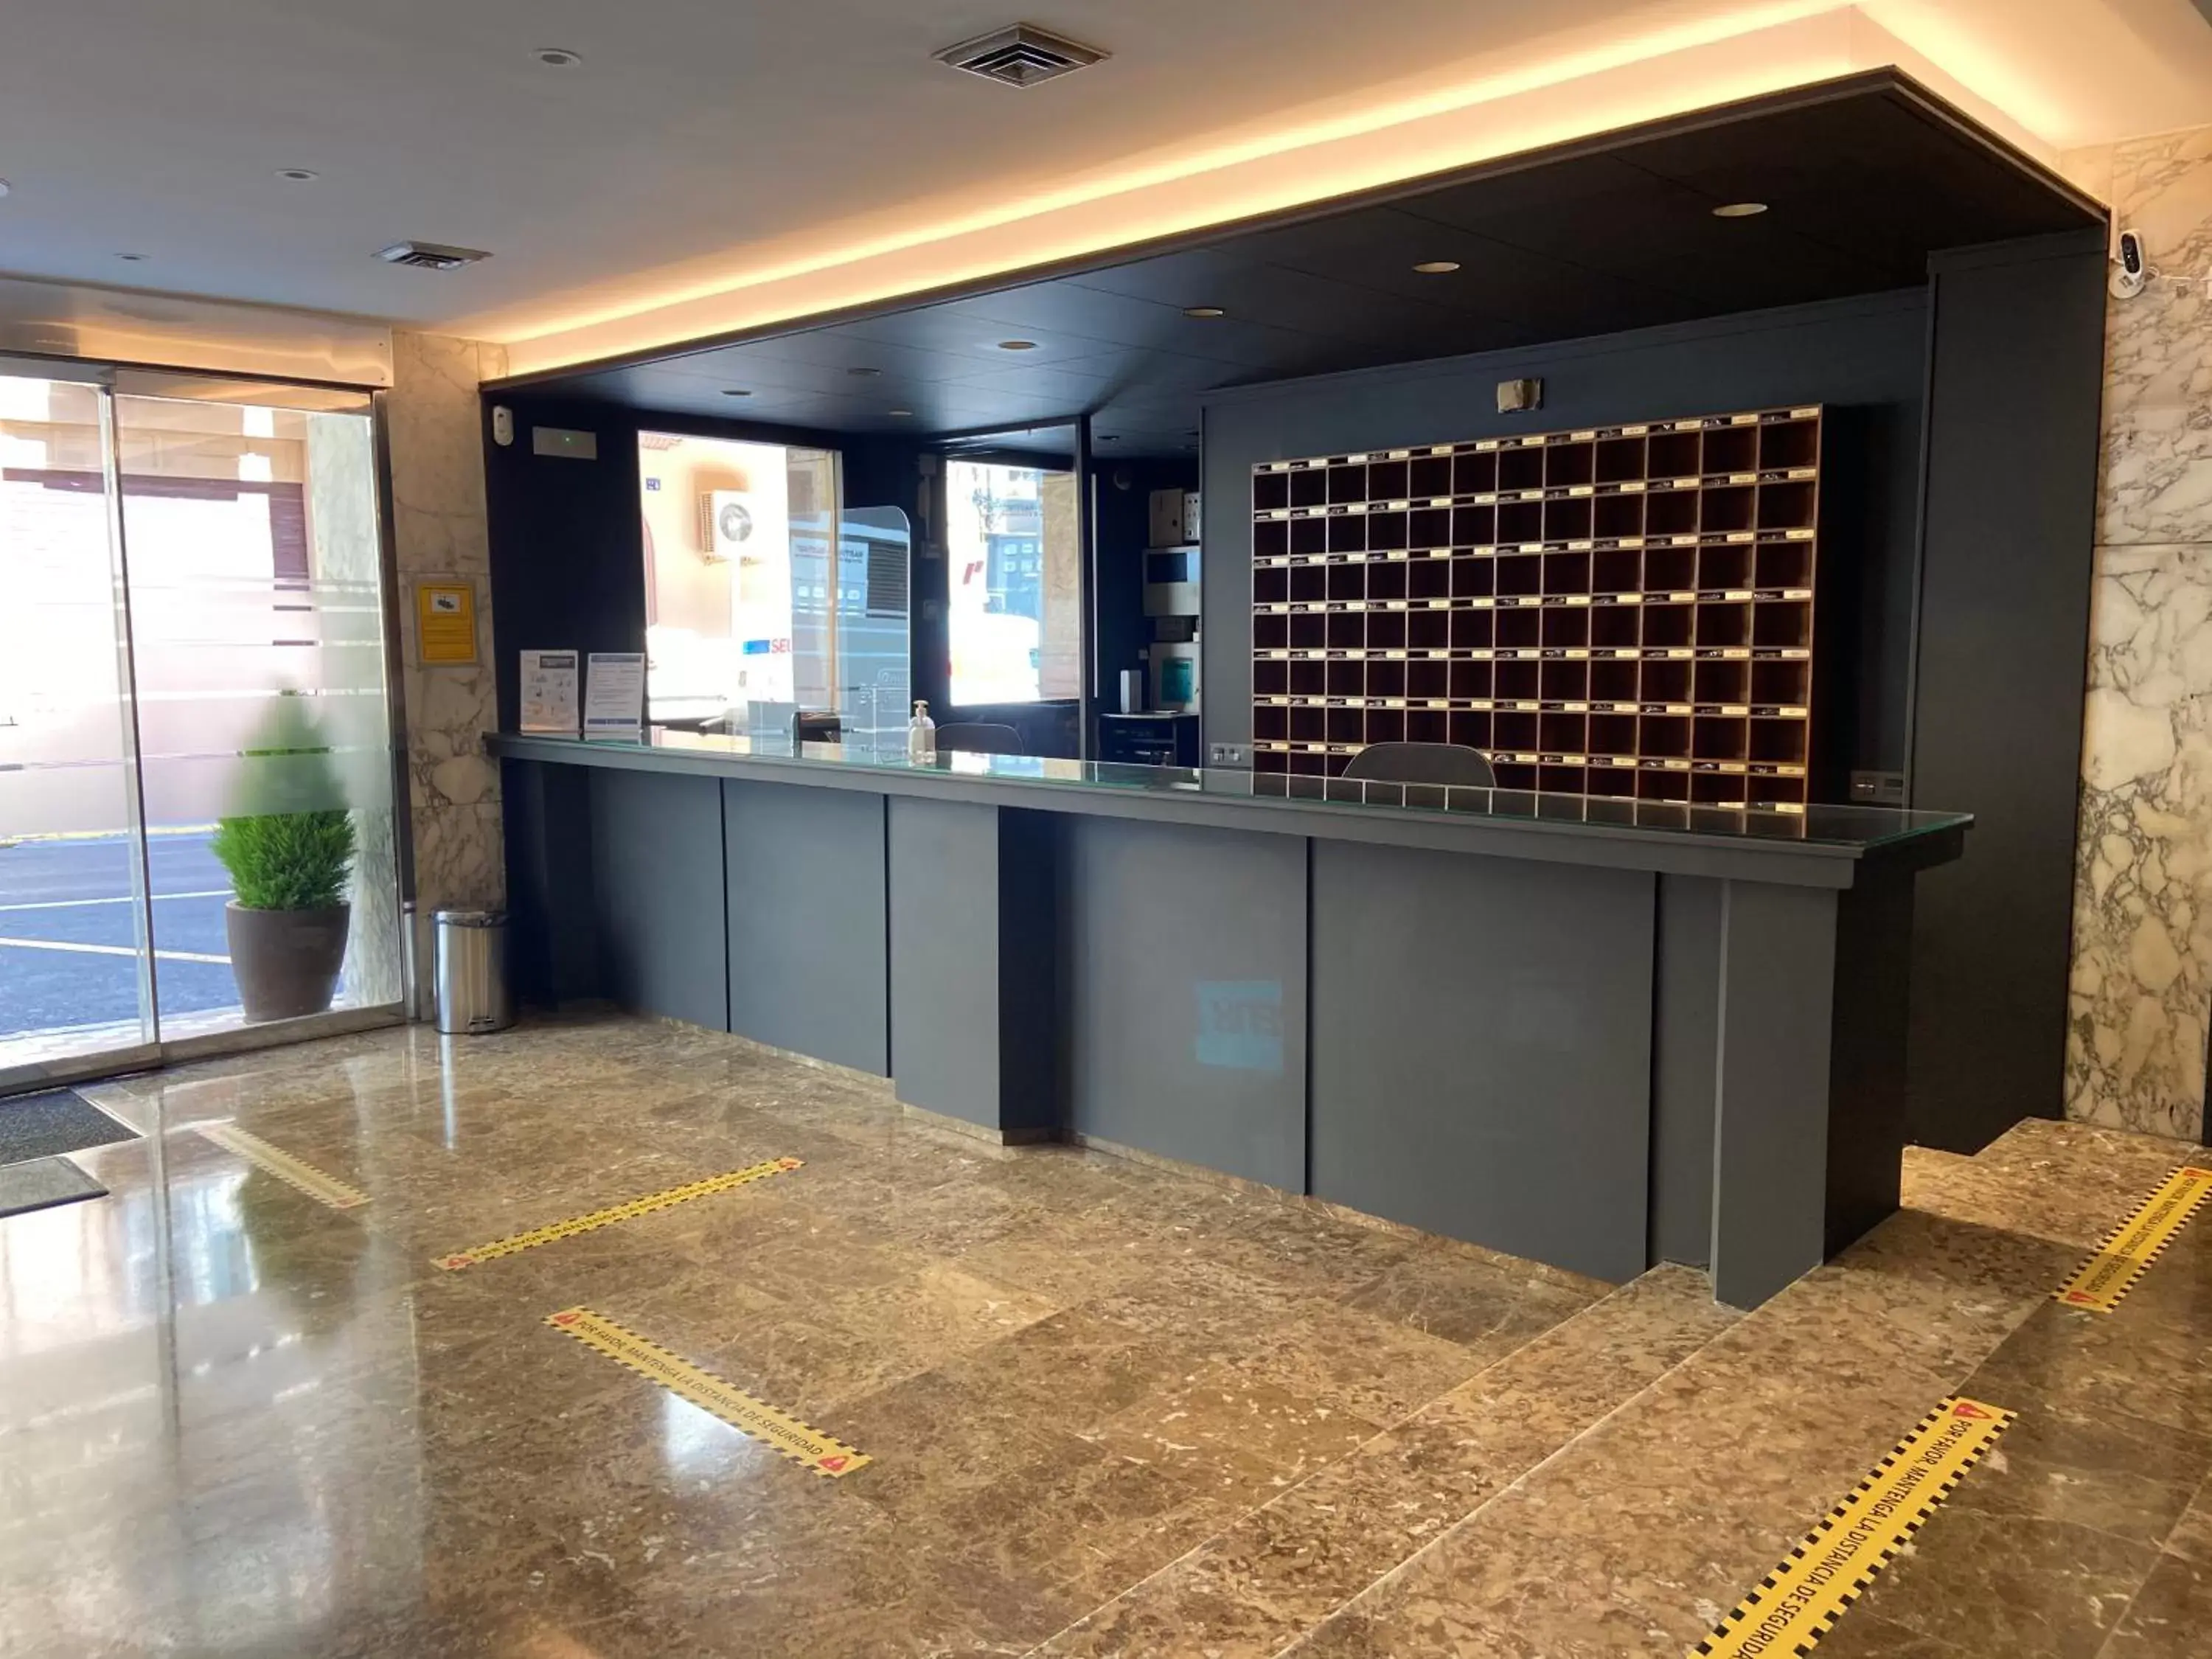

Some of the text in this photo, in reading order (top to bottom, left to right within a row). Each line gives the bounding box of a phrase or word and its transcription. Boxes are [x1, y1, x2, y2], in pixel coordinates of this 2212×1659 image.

[625, 1346, 681, 1377] MANTENGA
[676, 1374, 695, 1385] LA
[690, 1382, 746, 1413] DISTANCIA
[742, 1410, 764, 1422] DE
[757, 1419, 824, 1455] SEGURIDAD
[1944, 1419, 1973, 1438] POR
[1913, 1436, 1957, 1465] FAVOR,
[1867, 1465, 1930, 1519] MANTENGA
[1854, 1517, 1882, 1532] LA
[1804, 1530, 1868, 1586] DISTANCIA
[1788, 1585, 1818, 1604] DE
